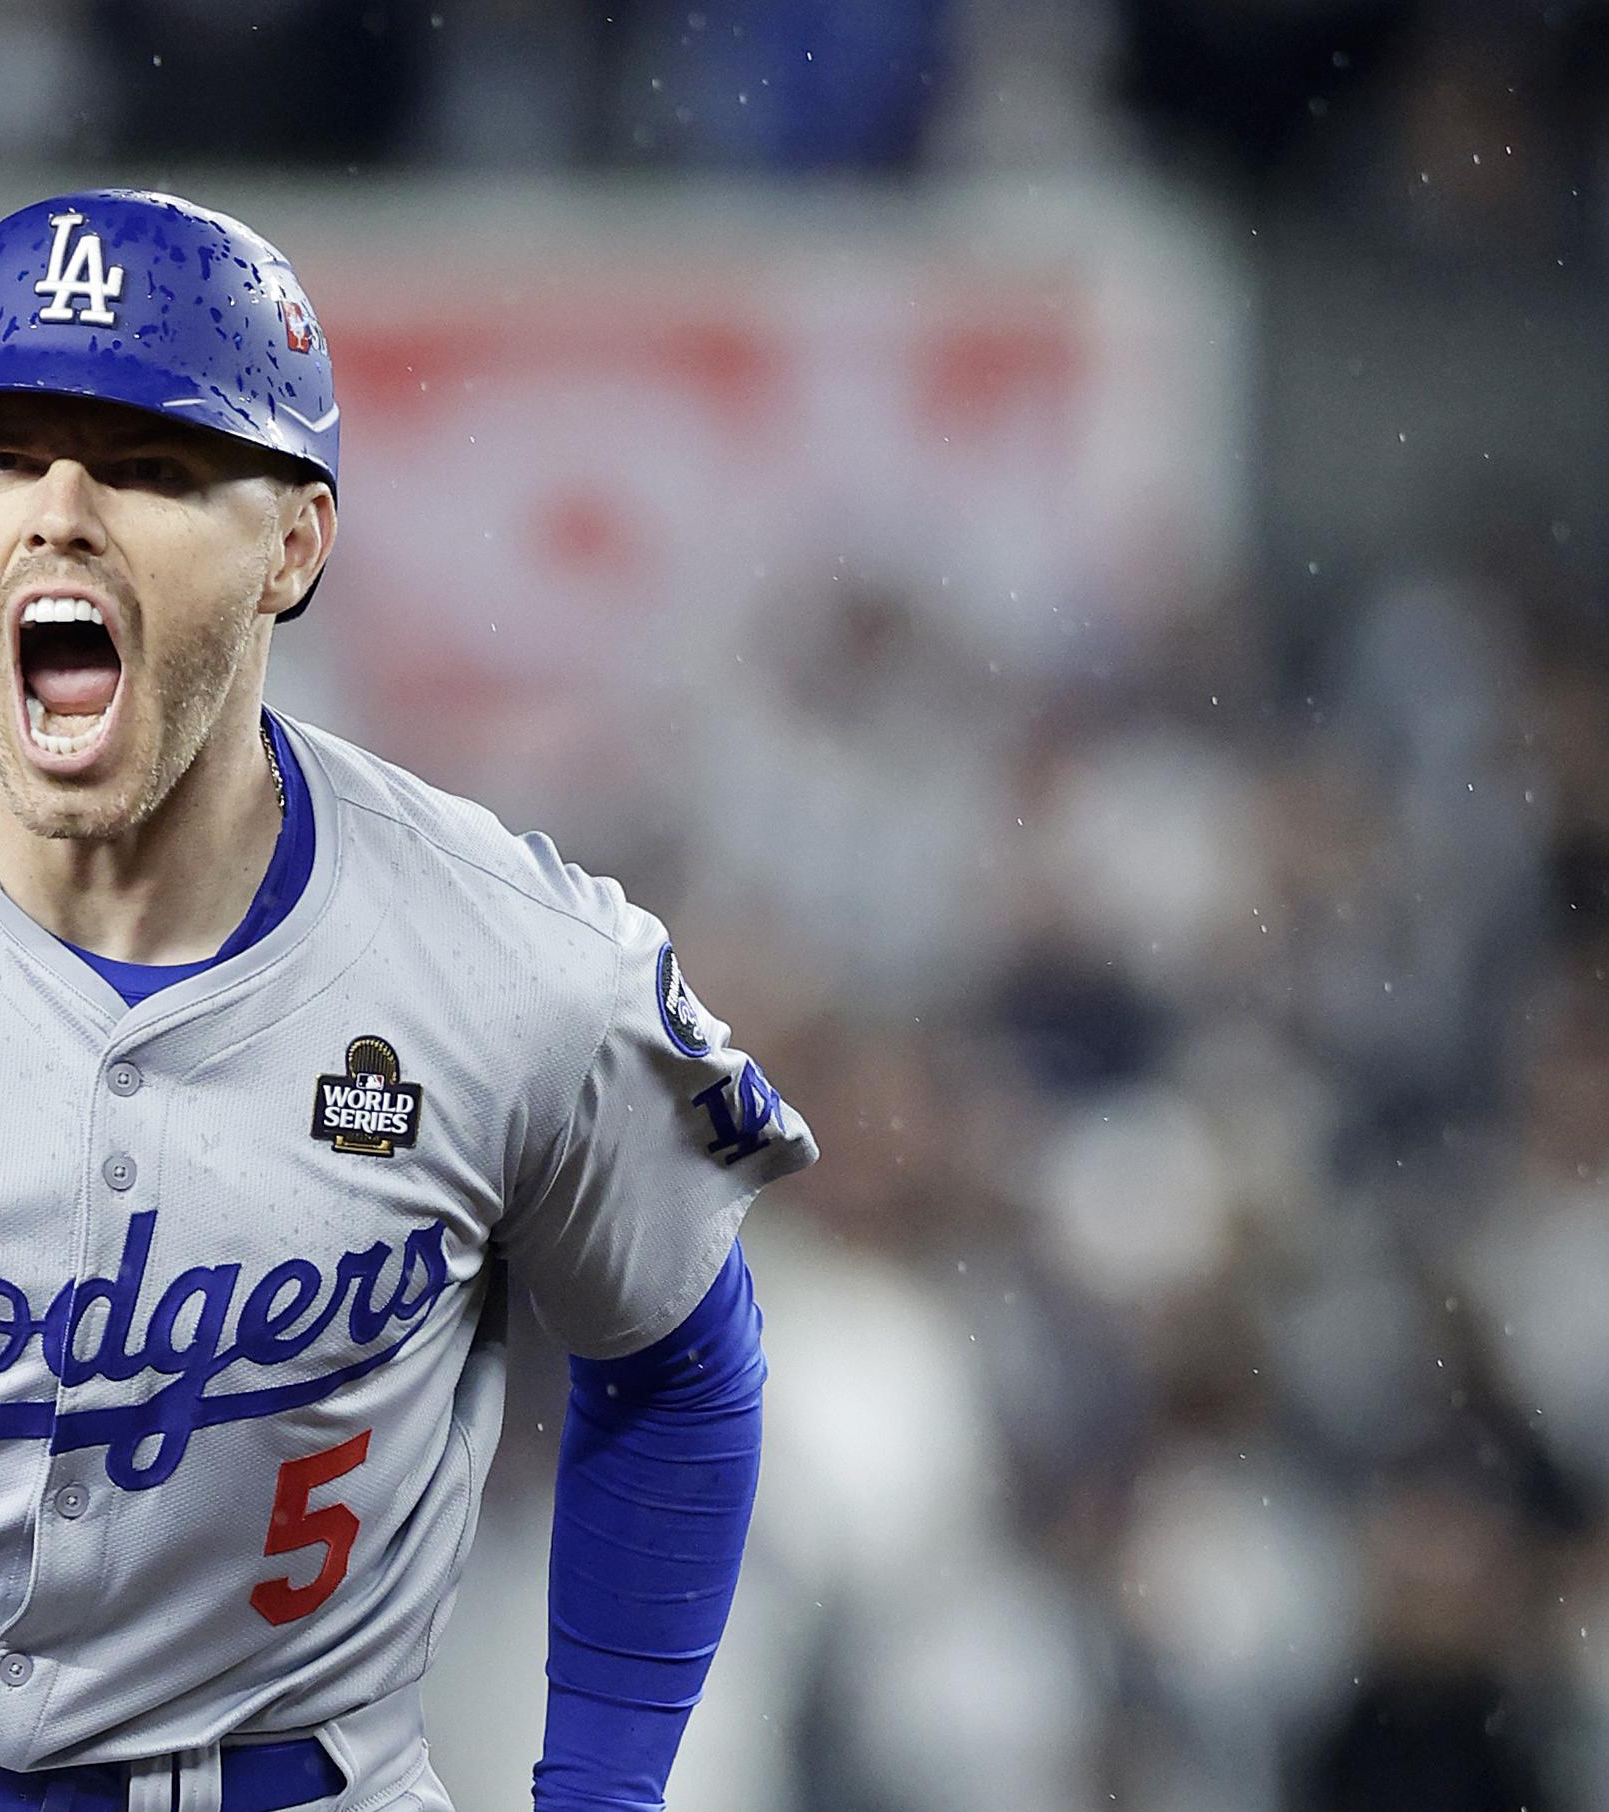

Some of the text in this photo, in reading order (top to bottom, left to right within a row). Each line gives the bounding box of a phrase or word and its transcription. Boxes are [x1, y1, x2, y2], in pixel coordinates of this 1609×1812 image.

[34, 213, 124, 326] LA
[322, 1084, 414, 1113] WORLD
[323, 1106, 409, 1134] SERIES
[692, 1059, 786, 1166] LA
[249, 1428, 372, 1626] 5
